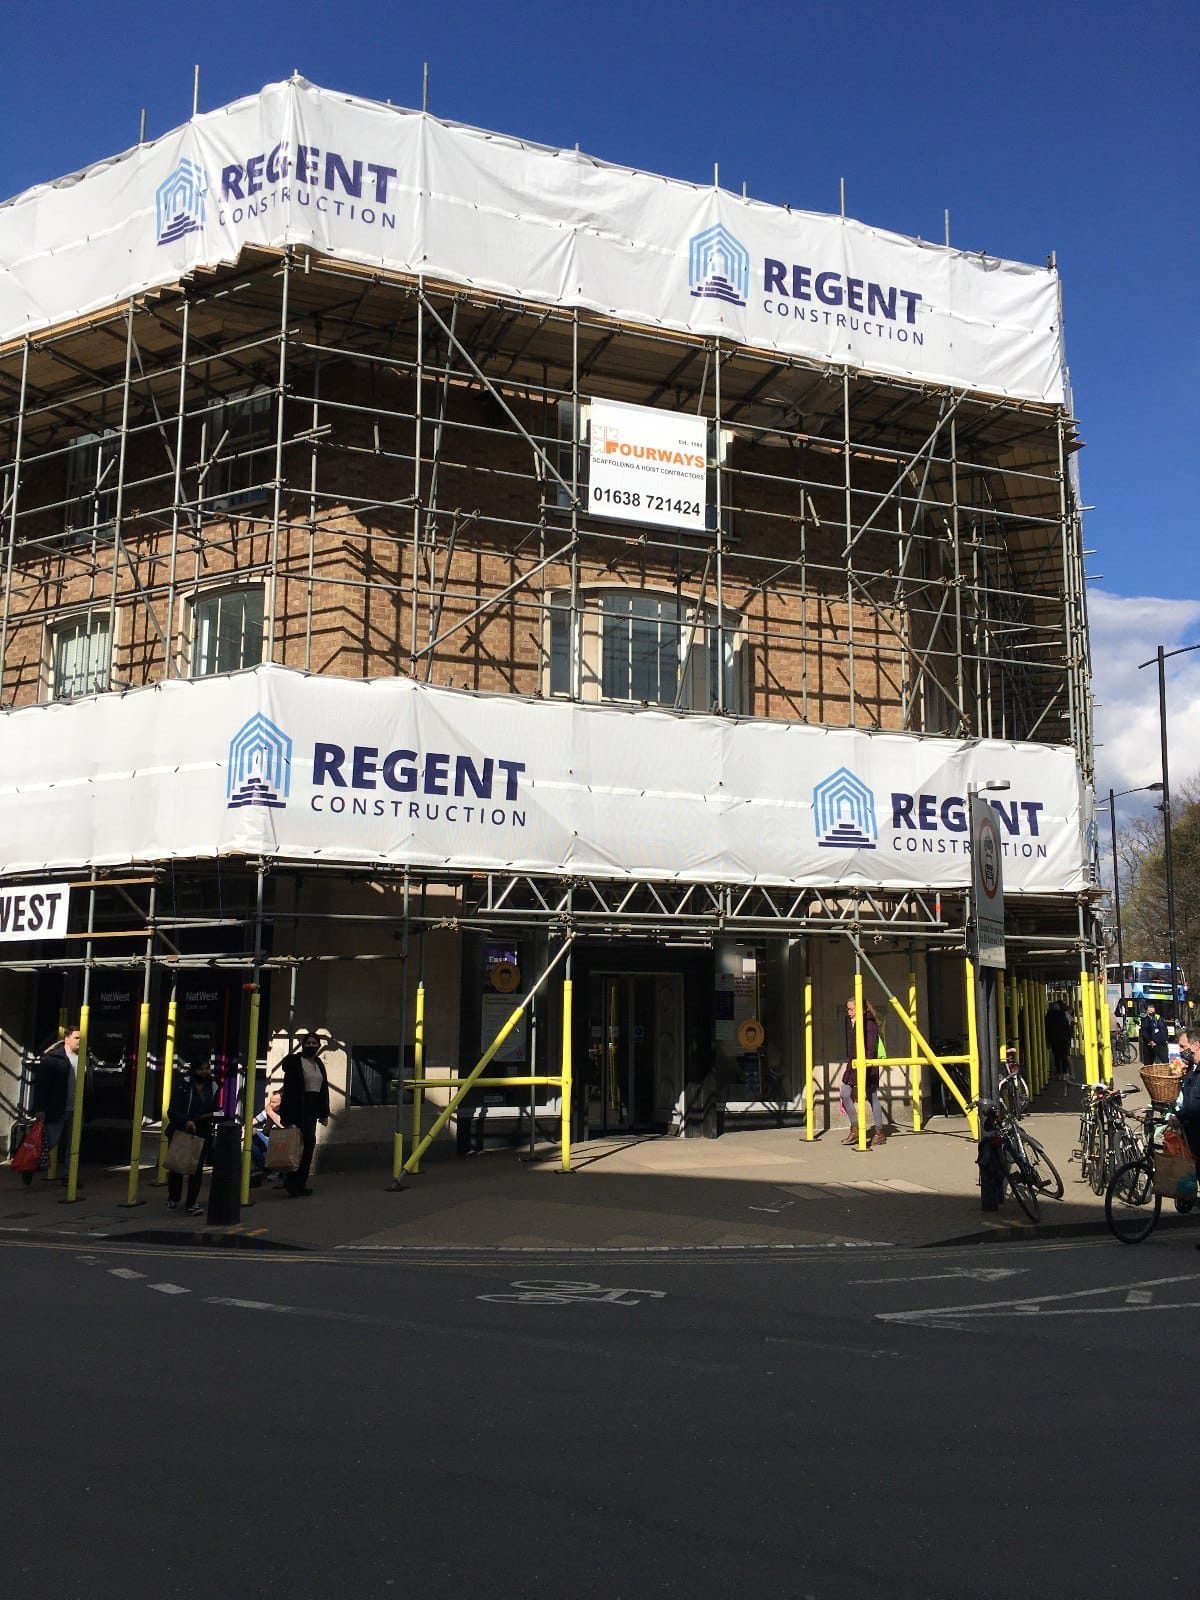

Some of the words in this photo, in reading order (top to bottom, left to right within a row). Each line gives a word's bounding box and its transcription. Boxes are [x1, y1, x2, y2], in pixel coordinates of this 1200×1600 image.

[220, 141, 397, 204] REGENT
[218, 187, 396, 229] CONSTRUCTION
[764, 257, 923, 325] REGENT
[763, 299, 924, 345] CONSTRUCTION
[592, 457, 635, 470] SCAFFOLDING
[641, 465, 659, 473] HOIST
[660, 468, 705, 481] CONTRACTORS
[605, 441, 705, 469] FOURWAYS
[593, 486, 641, 507] 01638
[645, 494, 701, 516] 721424
[312, 742, 525, 802] REGENT
[311, 794, 526, 827] CONSTRUCTION
[891, 792, 1044, 837] REGNT
[893, 836, 1048, 858] CONSTRTION
[186, 991, 218, 1002] NatWest
